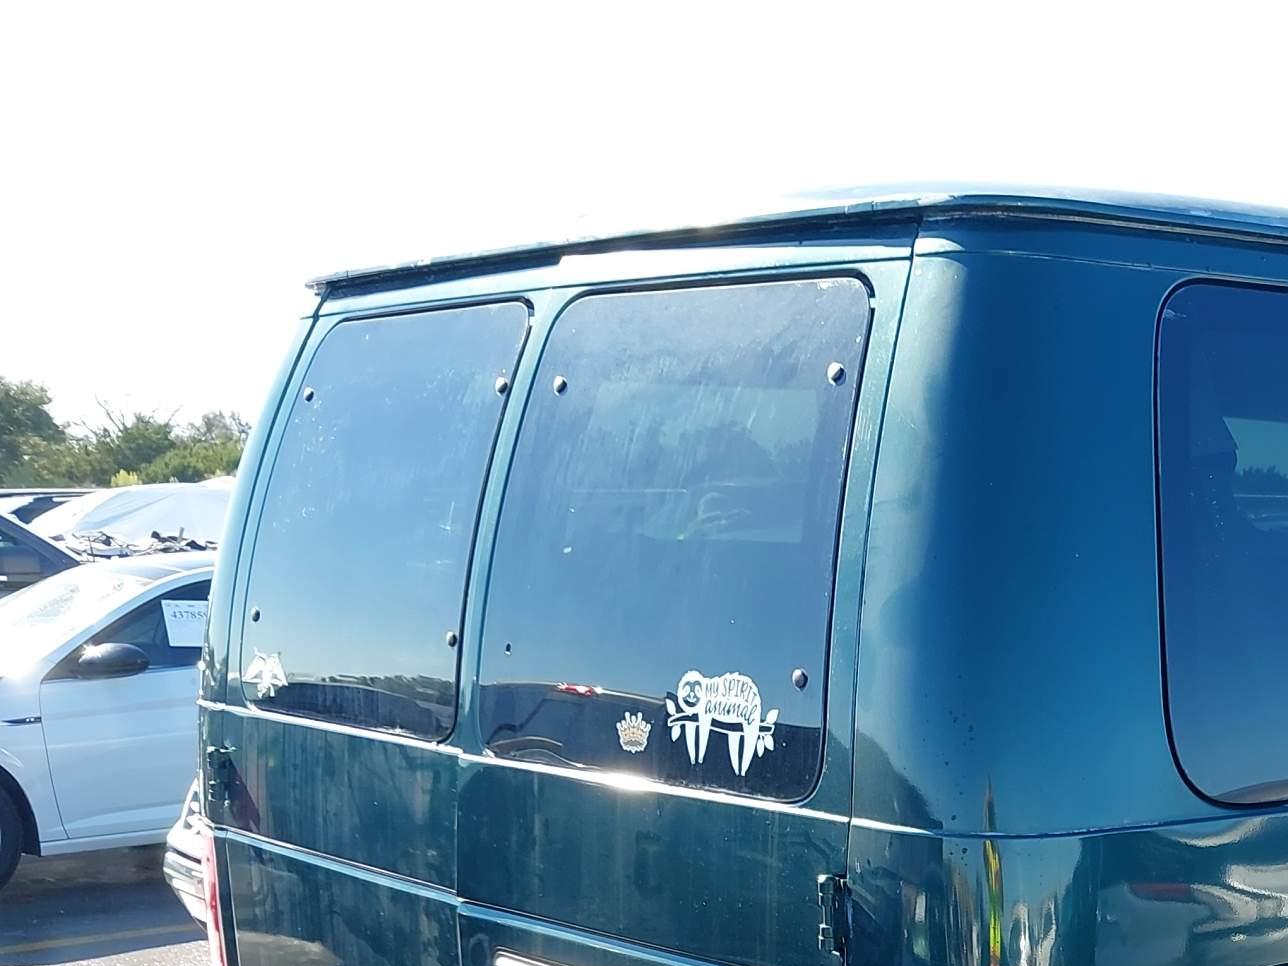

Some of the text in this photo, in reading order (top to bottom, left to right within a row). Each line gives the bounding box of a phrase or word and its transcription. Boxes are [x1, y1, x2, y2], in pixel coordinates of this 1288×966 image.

[705, 677, 758, 705] MY SPIRIT
[704, 699, 758, 725] animal
